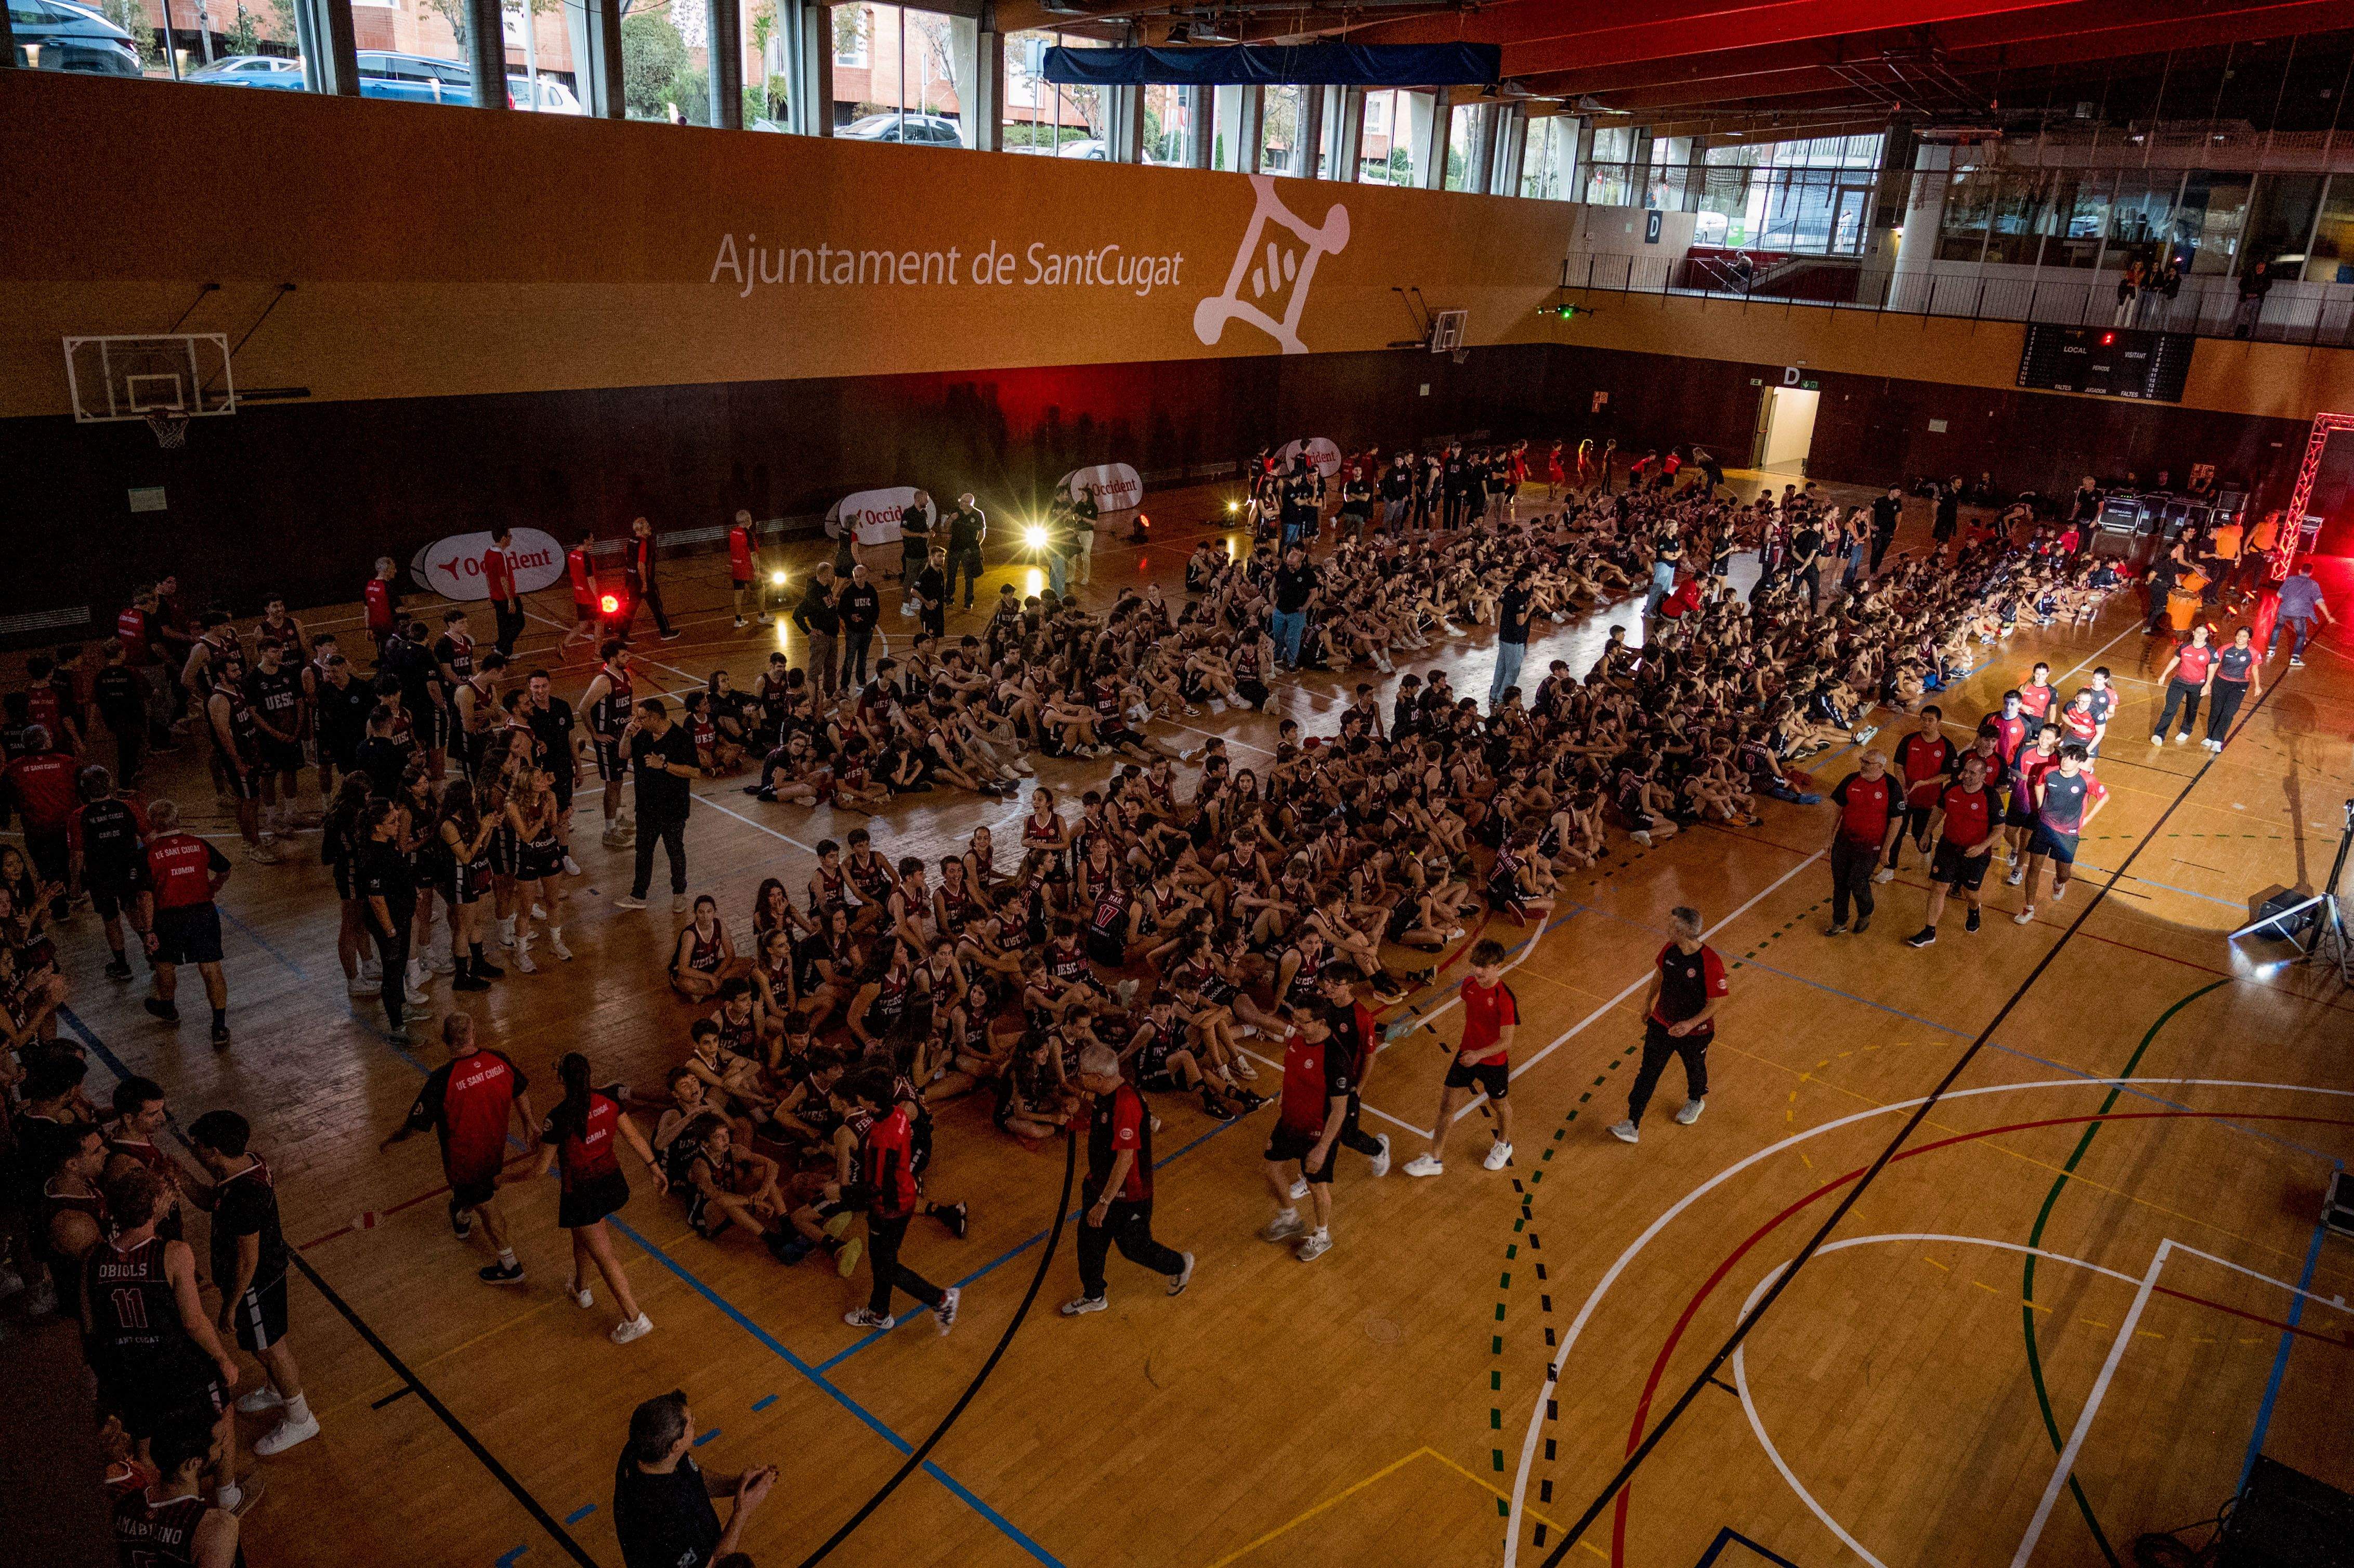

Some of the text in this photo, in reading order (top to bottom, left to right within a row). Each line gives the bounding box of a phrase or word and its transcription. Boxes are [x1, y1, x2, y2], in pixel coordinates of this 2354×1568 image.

[1650, 216, 1659, 237] D
[710, 234, 1183, 298] Ajuntament de SantCugat
[1784, 367, 1800, 385] D
[1092, 479, 1137, 496] Occident
[866, 505, 903, 525] Occid
[265, 691, 294, 710] UESC
[99, 830, 120, 839] CARLOS
[165, 847, 180, 857] SANT
[181, 845, 200, 855] CUGAT
[171, 866, 195, 876] TXOMIN
[1108, 893, 1123, 905] MAR
[1095, 903, 1119, 928] 17
[467, 1073, 485, 1087] SANT
[485, 1064, 505, 1080] CUGAT
[586, 1129, 607, 1144] CARLA
[99, 1263, 148, 1277] OBIOLS
[111, 1288, 149, 1328] 11
